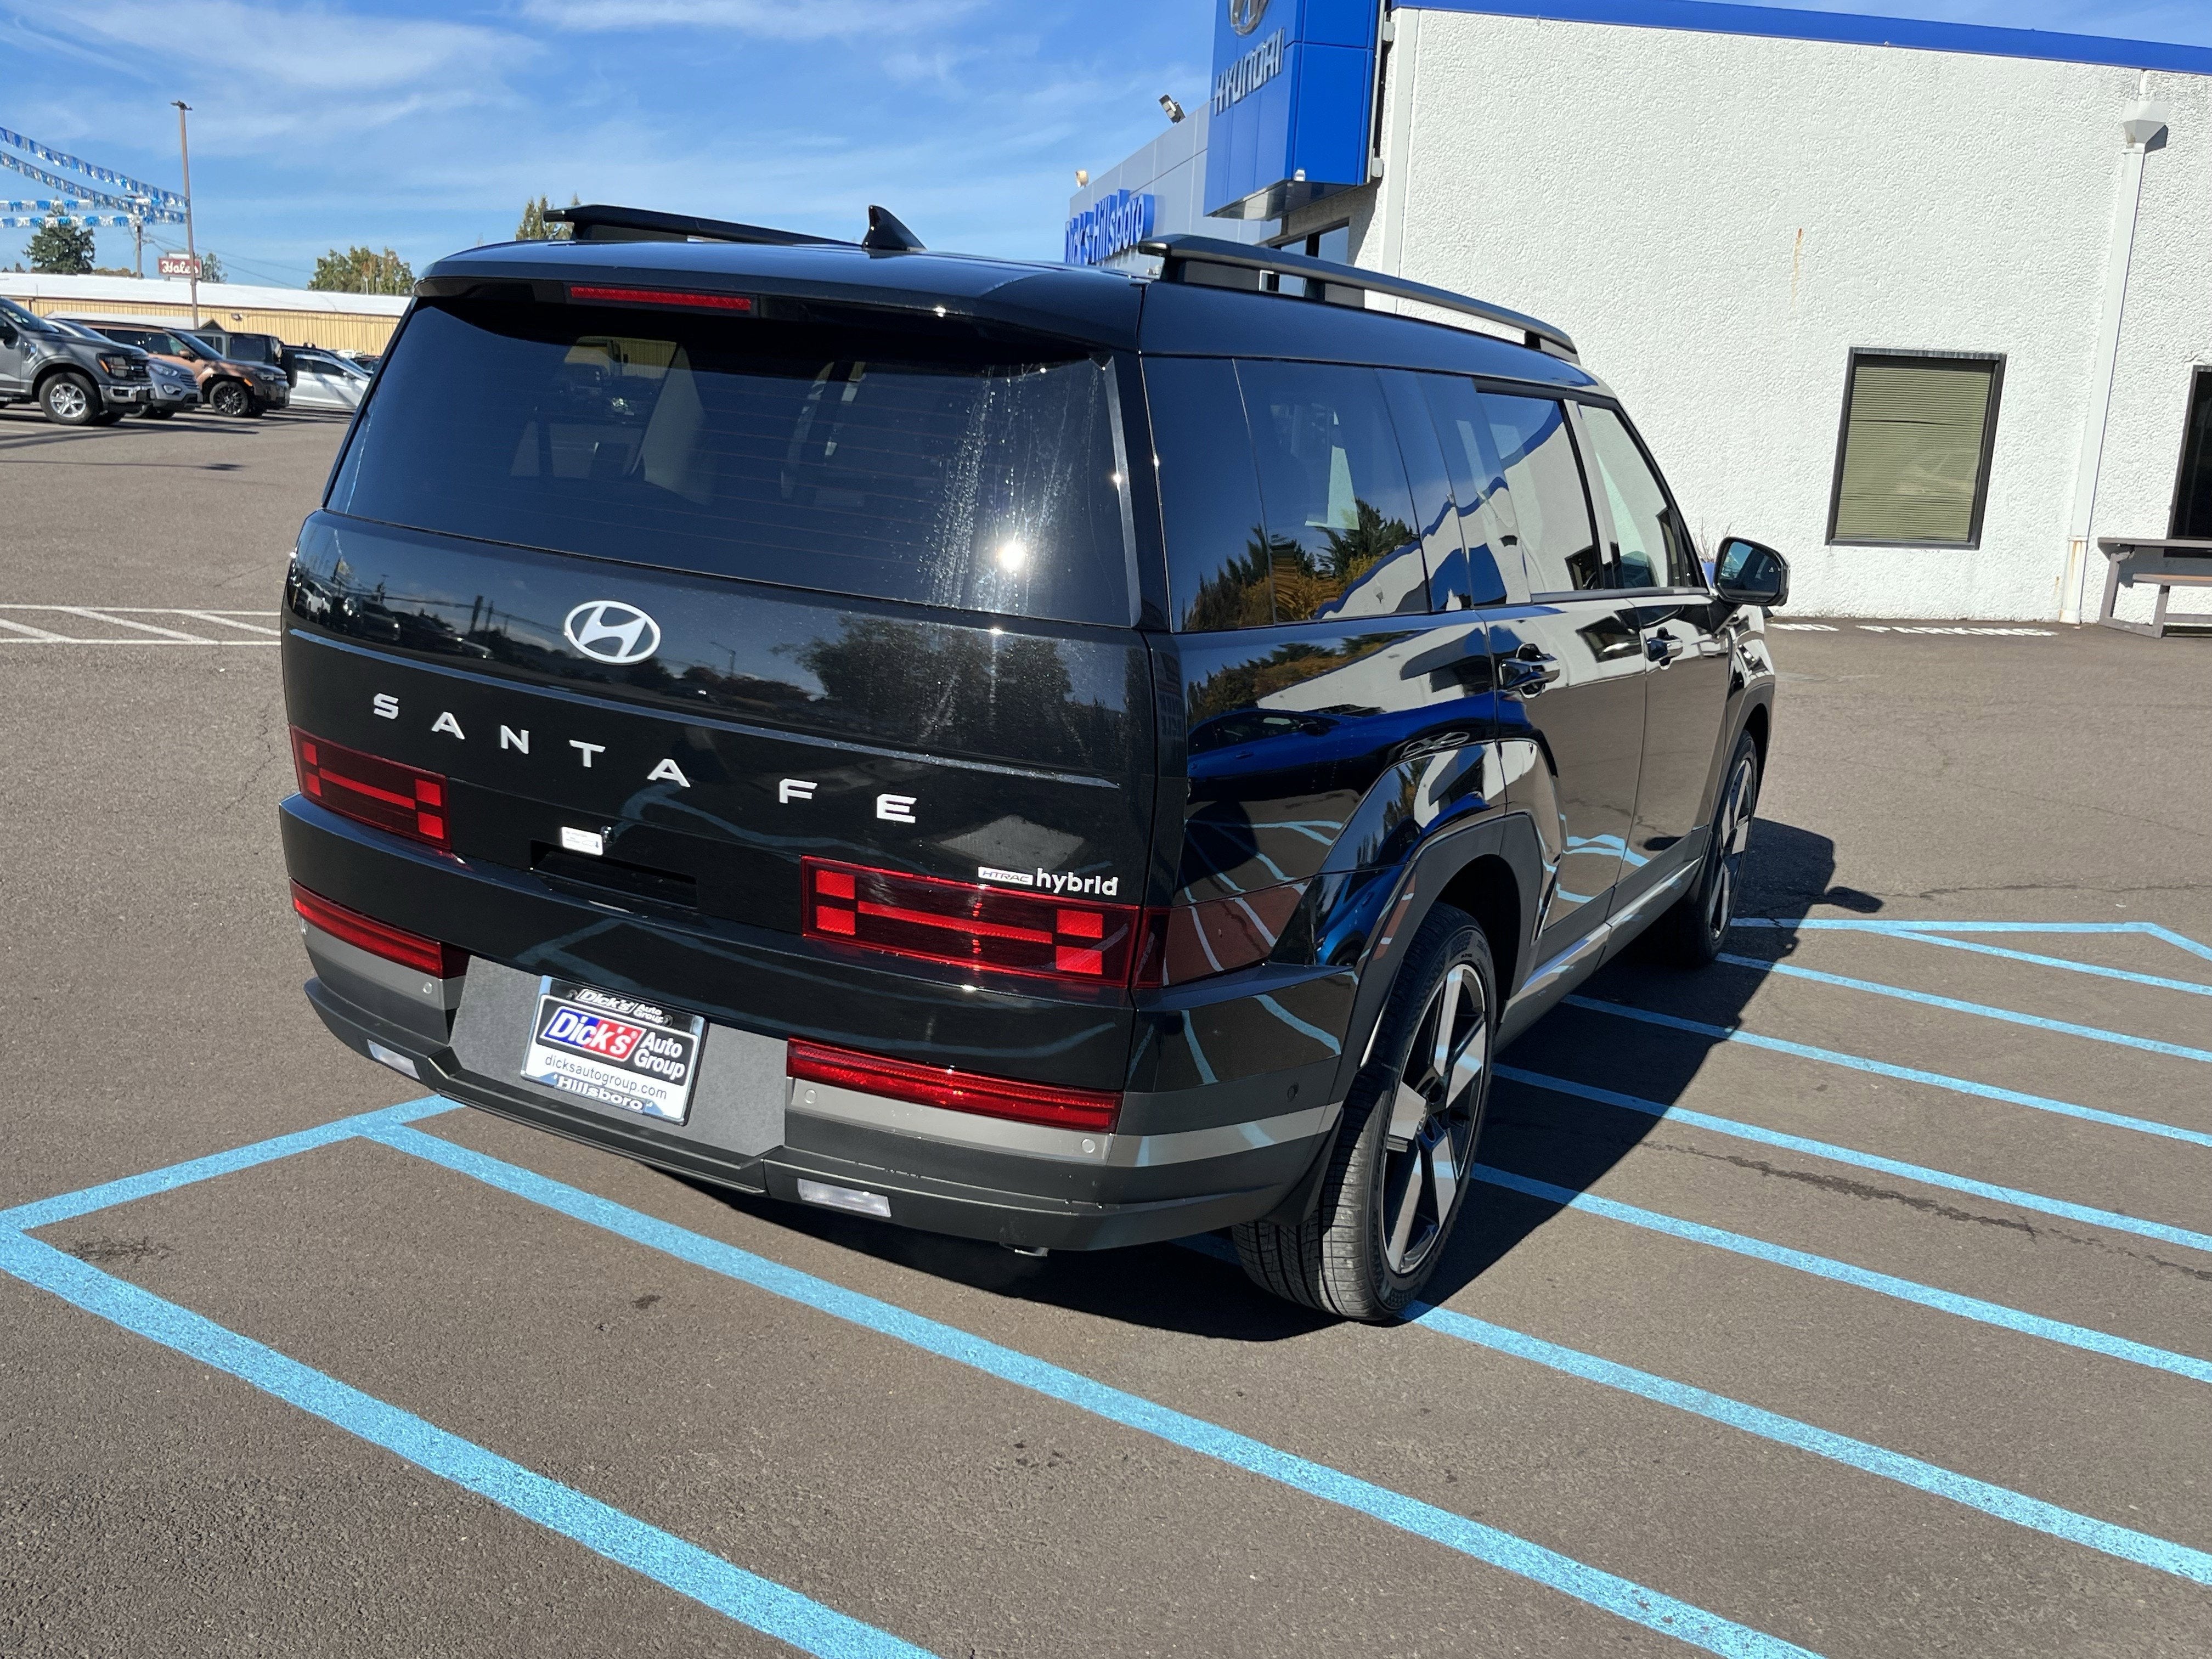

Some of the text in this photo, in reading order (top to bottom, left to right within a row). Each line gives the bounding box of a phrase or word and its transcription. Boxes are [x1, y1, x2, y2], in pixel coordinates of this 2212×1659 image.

[1215, 27, 1284, 116] HYUNDAI
[1091, 189, 1151, 264] Hillsboro
[374, 693, 917, 823] SANTA FE
[983, 870, 1030, 883] HTRAC
[1036, 867, 1118, 896] hybrid
[580, 991, 635, 1012] Dick's
[637, 1004, 663, 1015] Auto
[549, 1011, 633, 1054] Dick's
[641, 1032, 682, 1058] Auto
[545, 1054, 667, 1099] dicksautogroup.com
[634, 1050, 685, 1080] Group
[557, 1077, 644, 1110] Hillsboro
